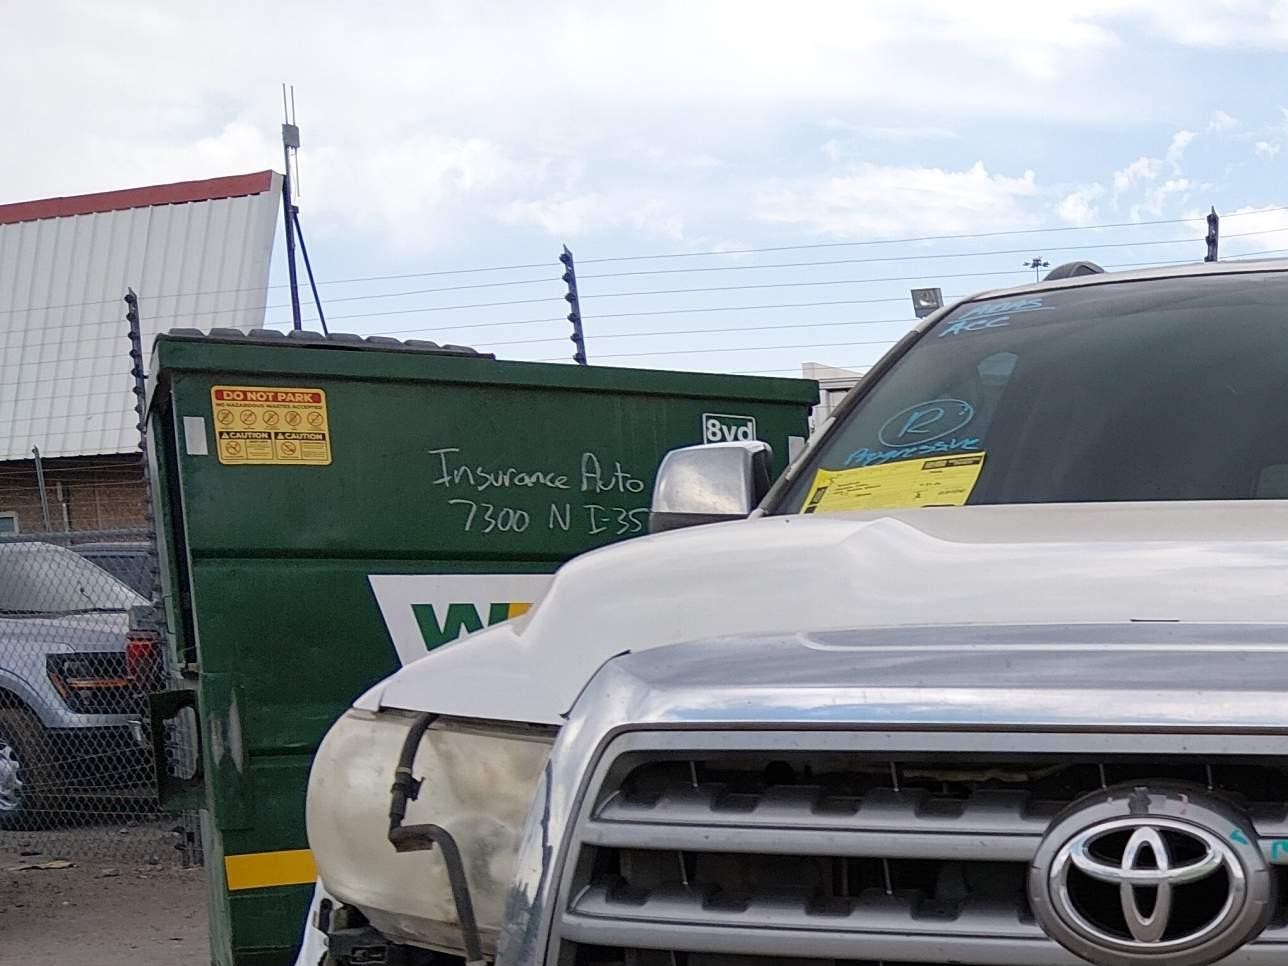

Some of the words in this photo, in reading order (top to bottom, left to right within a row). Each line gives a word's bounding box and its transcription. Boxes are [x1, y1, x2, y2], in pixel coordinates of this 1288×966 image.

[223, 391, 244, 400] DO
[246, 391, 275, 401] NOT
[277, 392, 313, 403] PARK
[284, 432, 323, 440] CAUTION
[428, 448, 571, 491] Insurance
[580, 452, 645, 493] Auto
[448, 498, 530, 533] 7300
[549, 503, 571, 530] N
[410, 603, 534, 652] W
